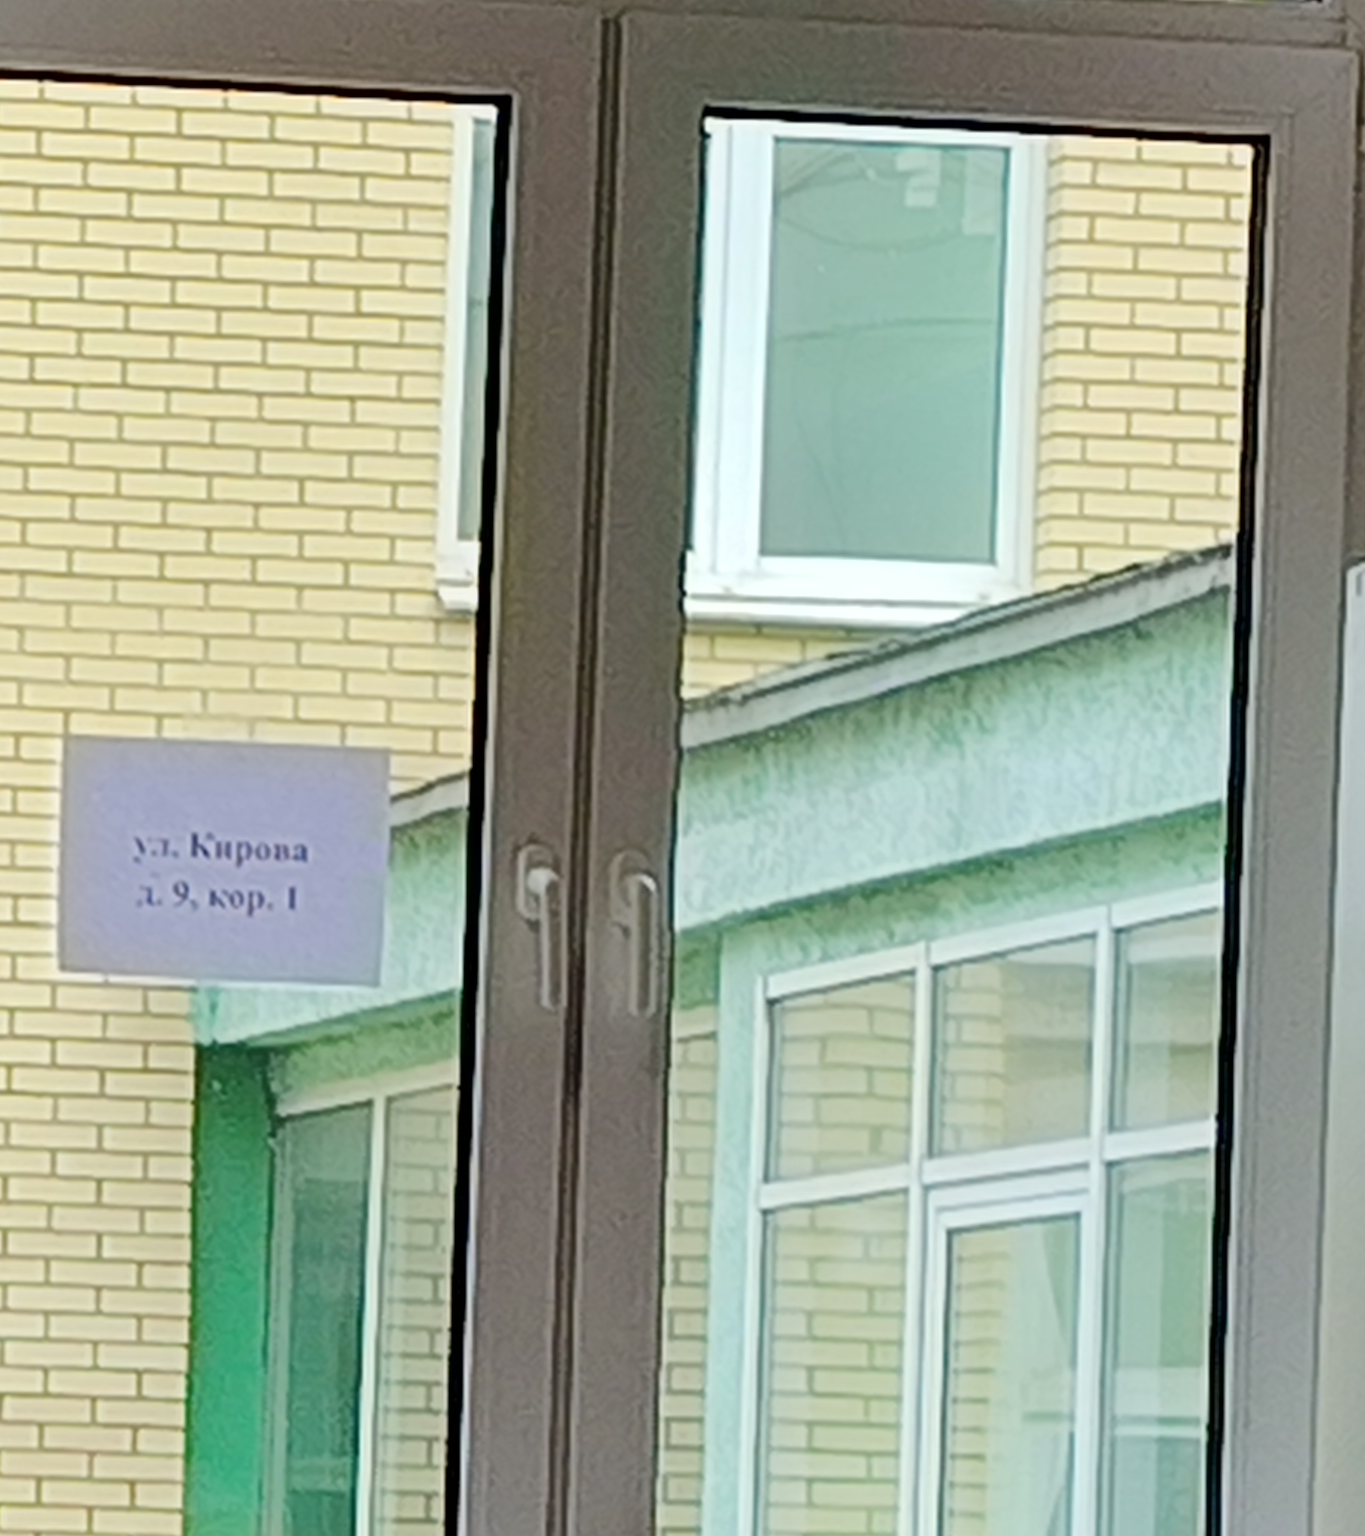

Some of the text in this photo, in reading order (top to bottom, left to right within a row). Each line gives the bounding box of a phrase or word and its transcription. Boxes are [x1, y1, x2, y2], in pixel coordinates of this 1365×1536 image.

[133, 832, 309, 868] ул. Кирова
[136, 880, 298, 917] д. 9, кор. 1
